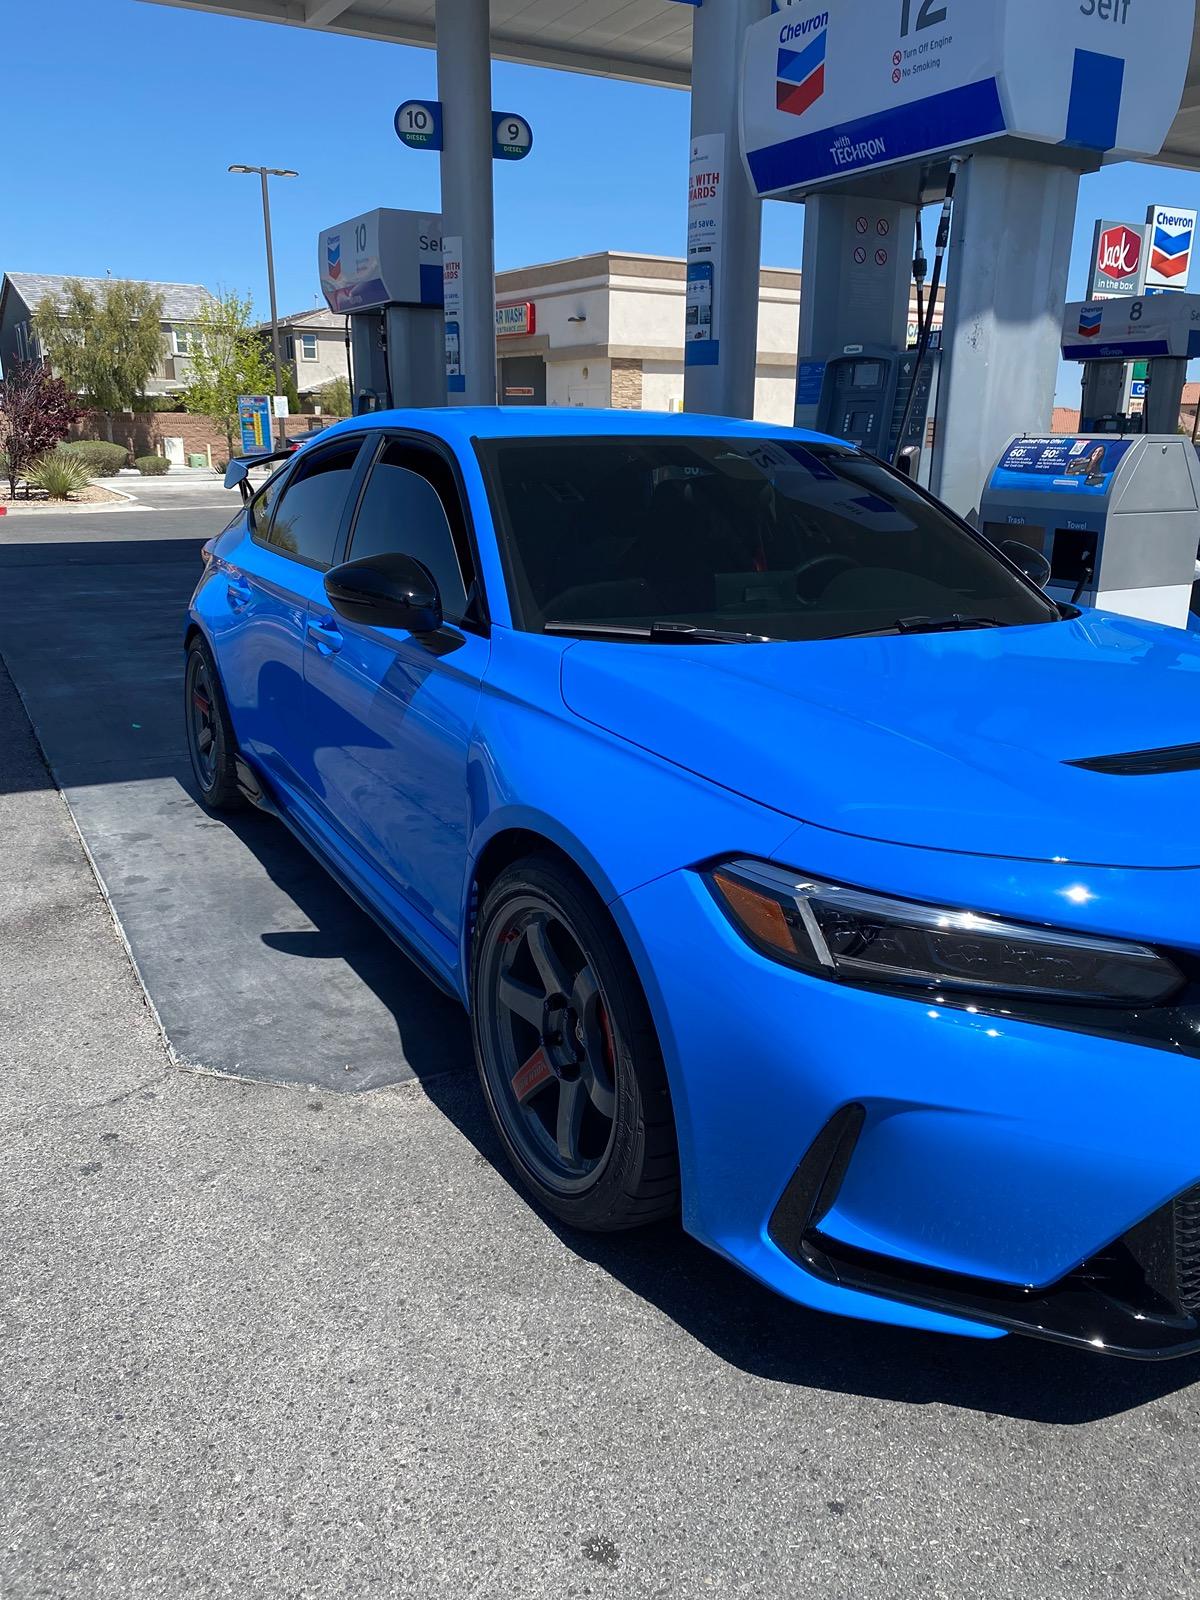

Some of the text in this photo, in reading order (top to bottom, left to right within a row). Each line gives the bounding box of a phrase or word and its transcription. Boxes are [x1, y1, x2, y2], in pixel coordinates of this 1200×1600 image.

[900, 0, 947, 38] 12
[1080, 0, 1131, 25] Self
[779, 11, 829, 44] Chevron
[903, 35, 953, 60] Turn Off Engine
[902, 58, 941, 77] No Smoking
[406, 110, 427, 130] 10
[406, 133, 427, 142] DIESEL
[507, 123, 519, 141] 9
[503, 145, 523, 154] DIESEL
[833, 136, 851, 149] with
[829, 137, 886, 166] TECHRON
[695, 172, 720, 187] WITH
[689, 186, 716, 202] WARDS
[698, 219, 716, 230] save.
[1156, 212, 1194, 228] Chevron
[355, 223, 367, 253] 10
[420, 235, 443, 252] Sel
[1099, 231, 1139, 272] Jack
[1097, 279, 1134, 290] in the box
[504, 307, 523, 323] WASH
[1129, 301, 1143, 321] 8
[1191, 309, 1200, 321] Se
[1007, 515, 1025, 525] Trash
[1067, 520, 1087, 530] Towel
